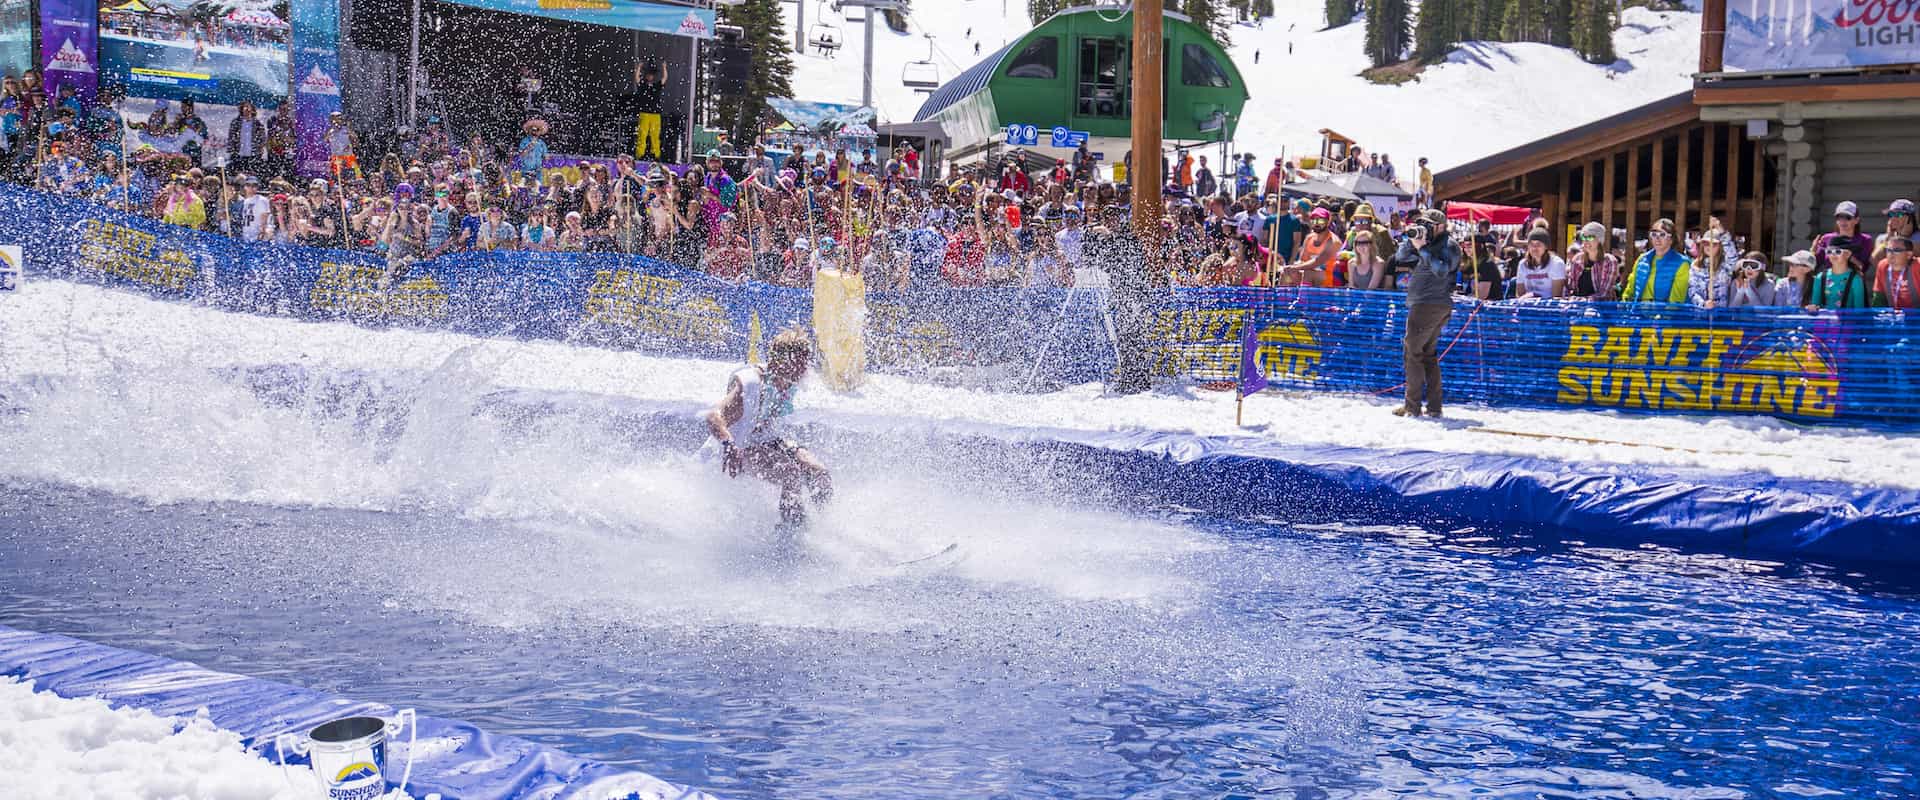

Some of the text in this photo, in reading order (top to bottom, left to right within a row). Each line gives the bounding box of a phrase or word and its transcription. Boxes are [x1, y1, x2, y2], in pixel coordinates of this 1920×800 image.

[55, 48, 88, 63] Coors
[1559, 325, 1744, 367] BANFF
[1557, 367, 1840, 417] SUNSHINE
